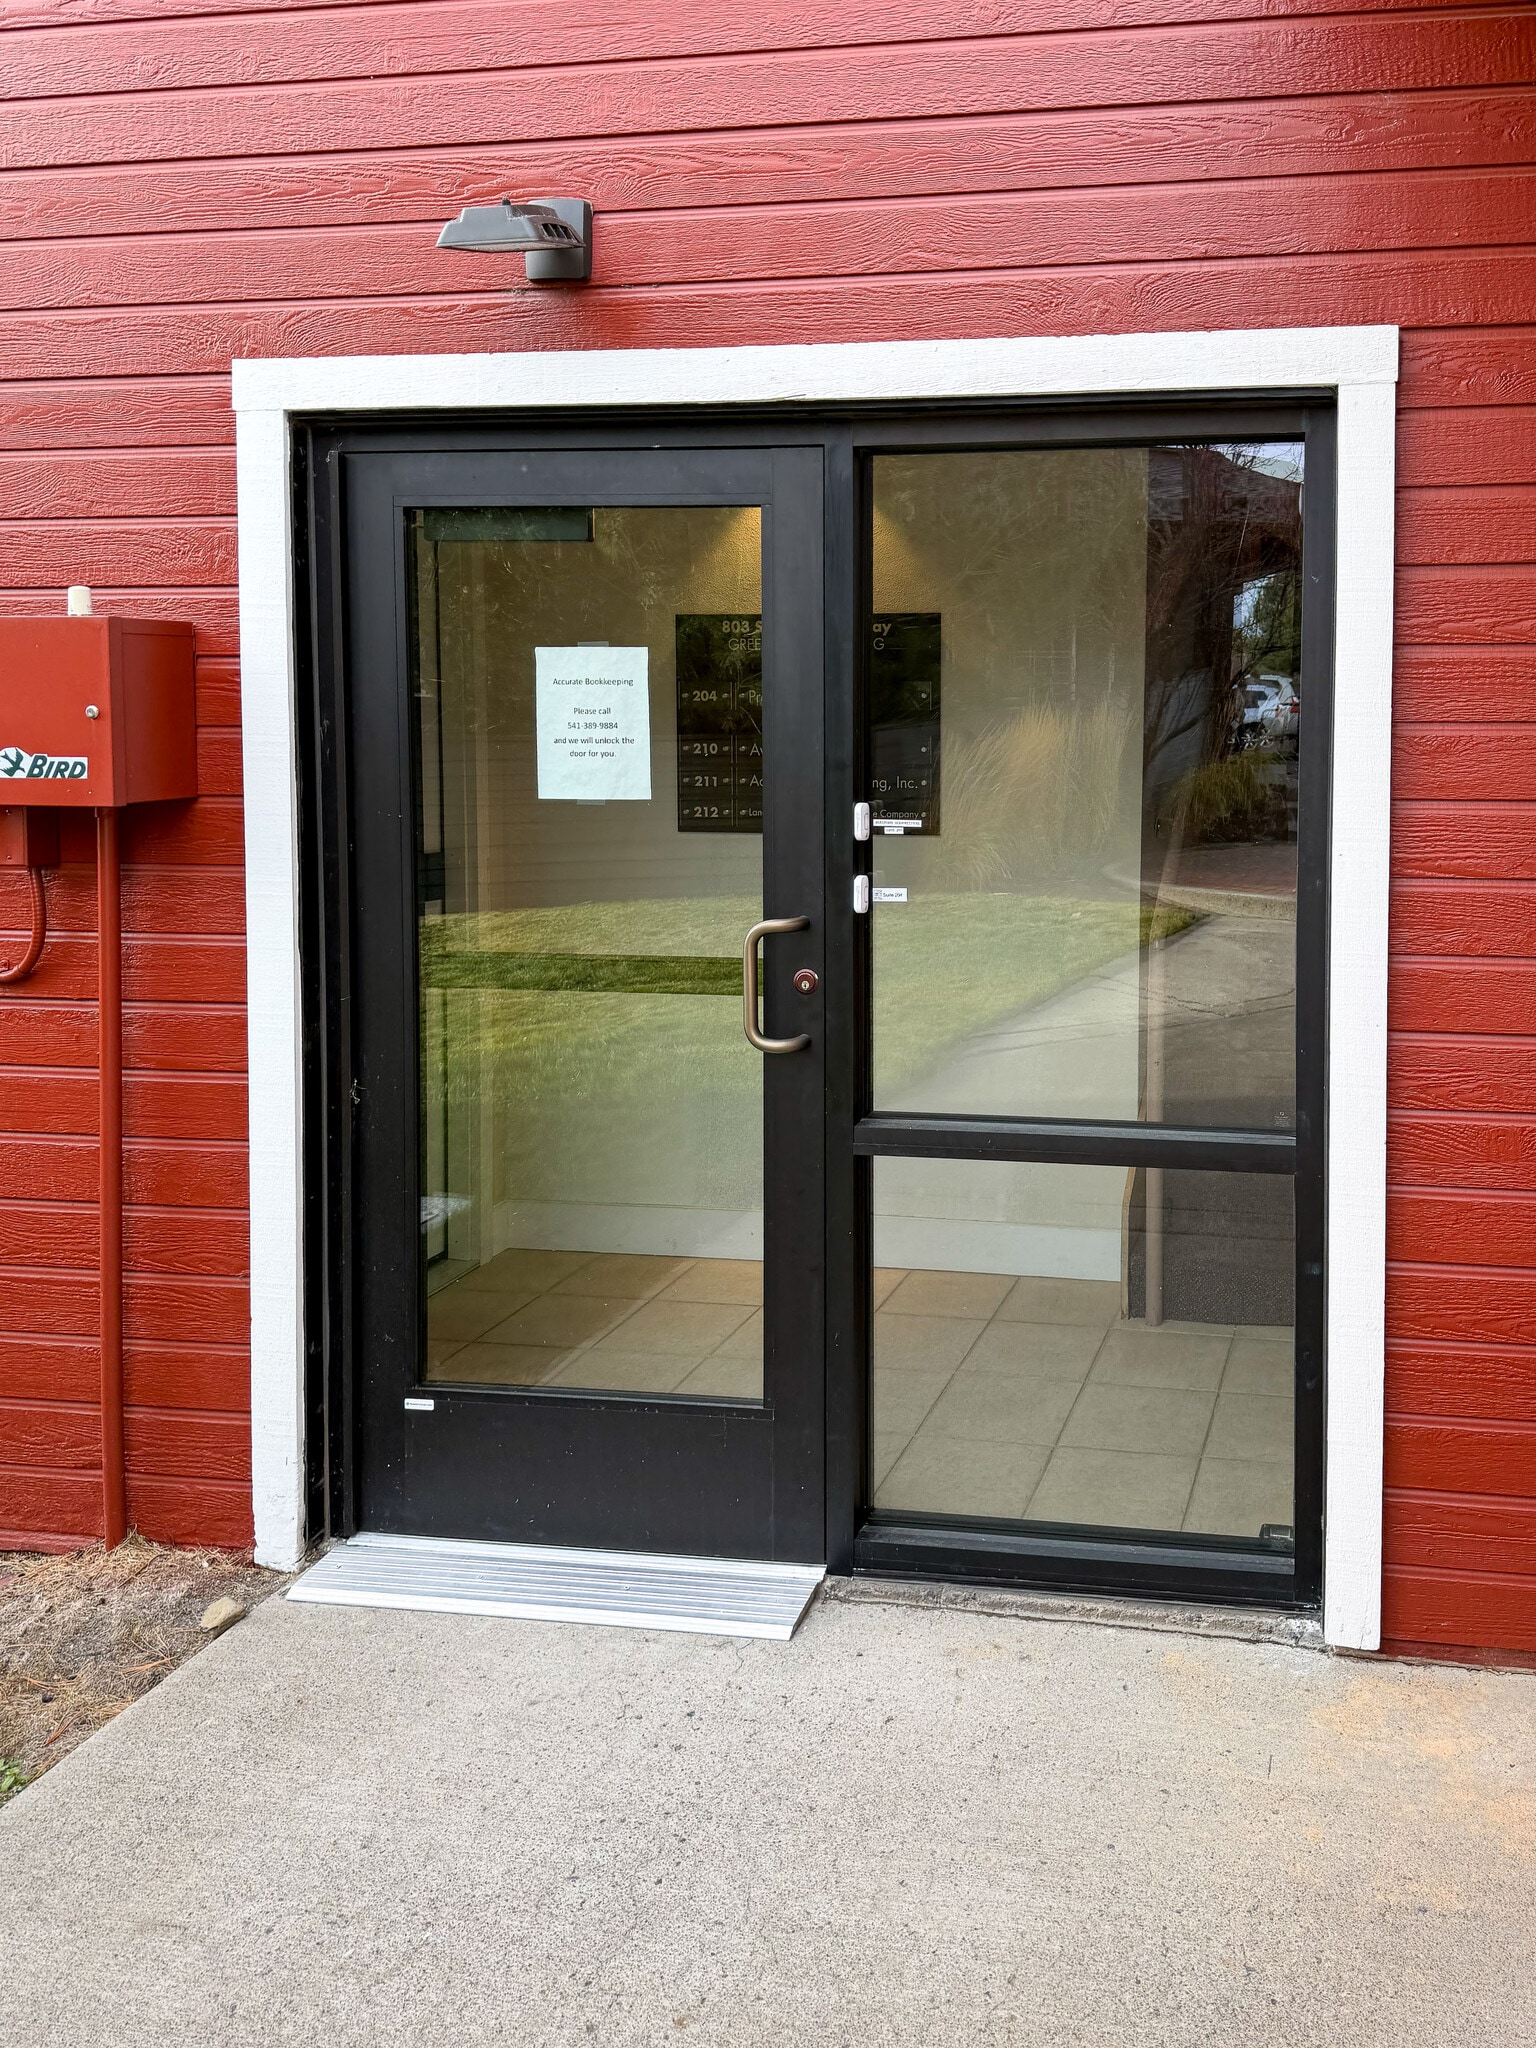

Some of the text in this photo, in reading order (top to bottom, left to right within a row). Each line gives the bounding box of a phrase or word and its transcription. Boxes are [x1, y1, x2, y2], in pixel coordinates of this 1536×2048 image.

[722, 620, 750, 633] 803
[872, 623, 892, 636] ay
[728, 638, 762, 651] GREE
[585, 677, 634, 687] Bookkeeping
[692, 690, 718, 702] 204
[693, 743, 718, 754] 210
[694, 775, 718, 787] 211
[896, 775, 918, 789] Inc.
[693, 806, 719, 818] 212
[880, 809, 919, 820] Company
